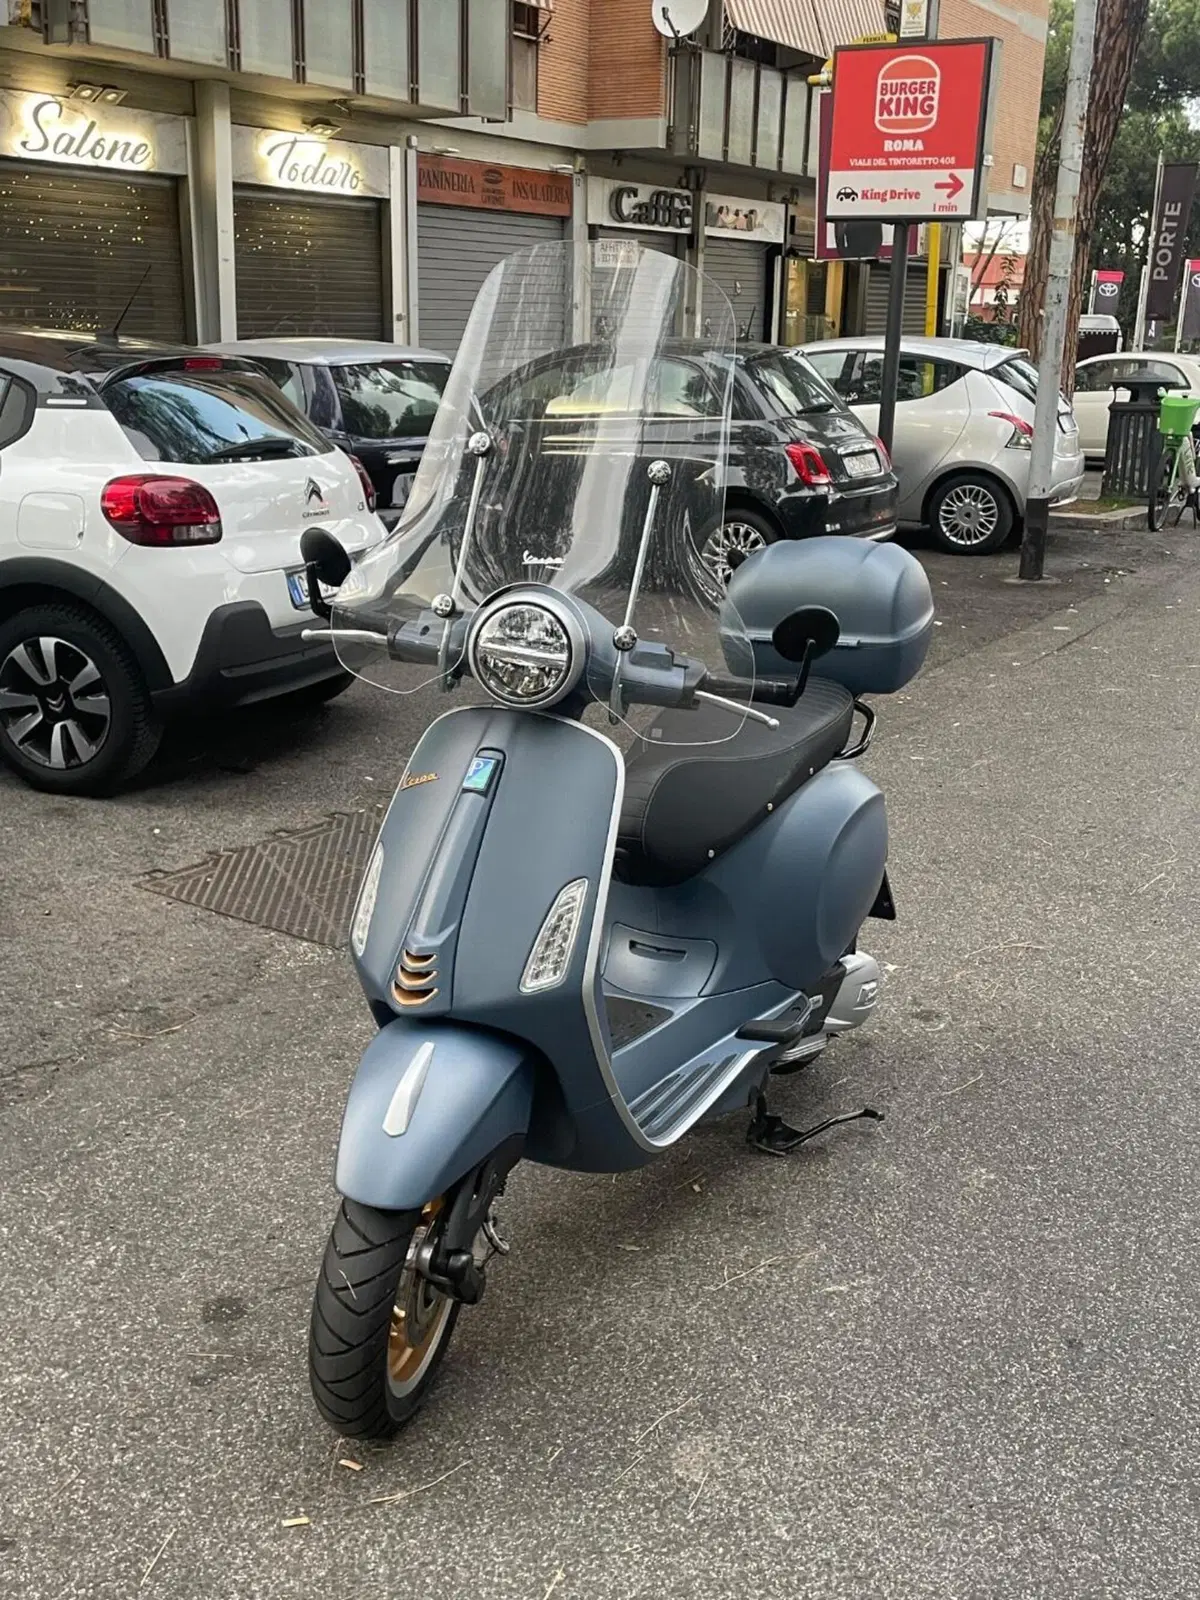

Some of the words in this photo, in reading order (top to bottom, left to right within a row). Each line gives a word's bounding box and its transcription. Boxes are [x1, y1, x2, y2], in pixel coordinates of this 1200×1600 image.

[880, 81, 936, 96] BURGER
[878, 96, 935, 117] KING
[20, 100, 152, 166] Salone
[884, 139, 924, 152] ROMA
[849, 158, 872, 166] VIALE
[873, 158, 887, 166] DEL
[888, 157, 938, 165] TINTORETTO
[418, 167, 475, 194] PANINERIA
[861, 188, 888, 202] King
[889, 188, 921, 200] Drive
[938, 202, 958, 212] min
[1153, 201, 1181, 281] PORTE
